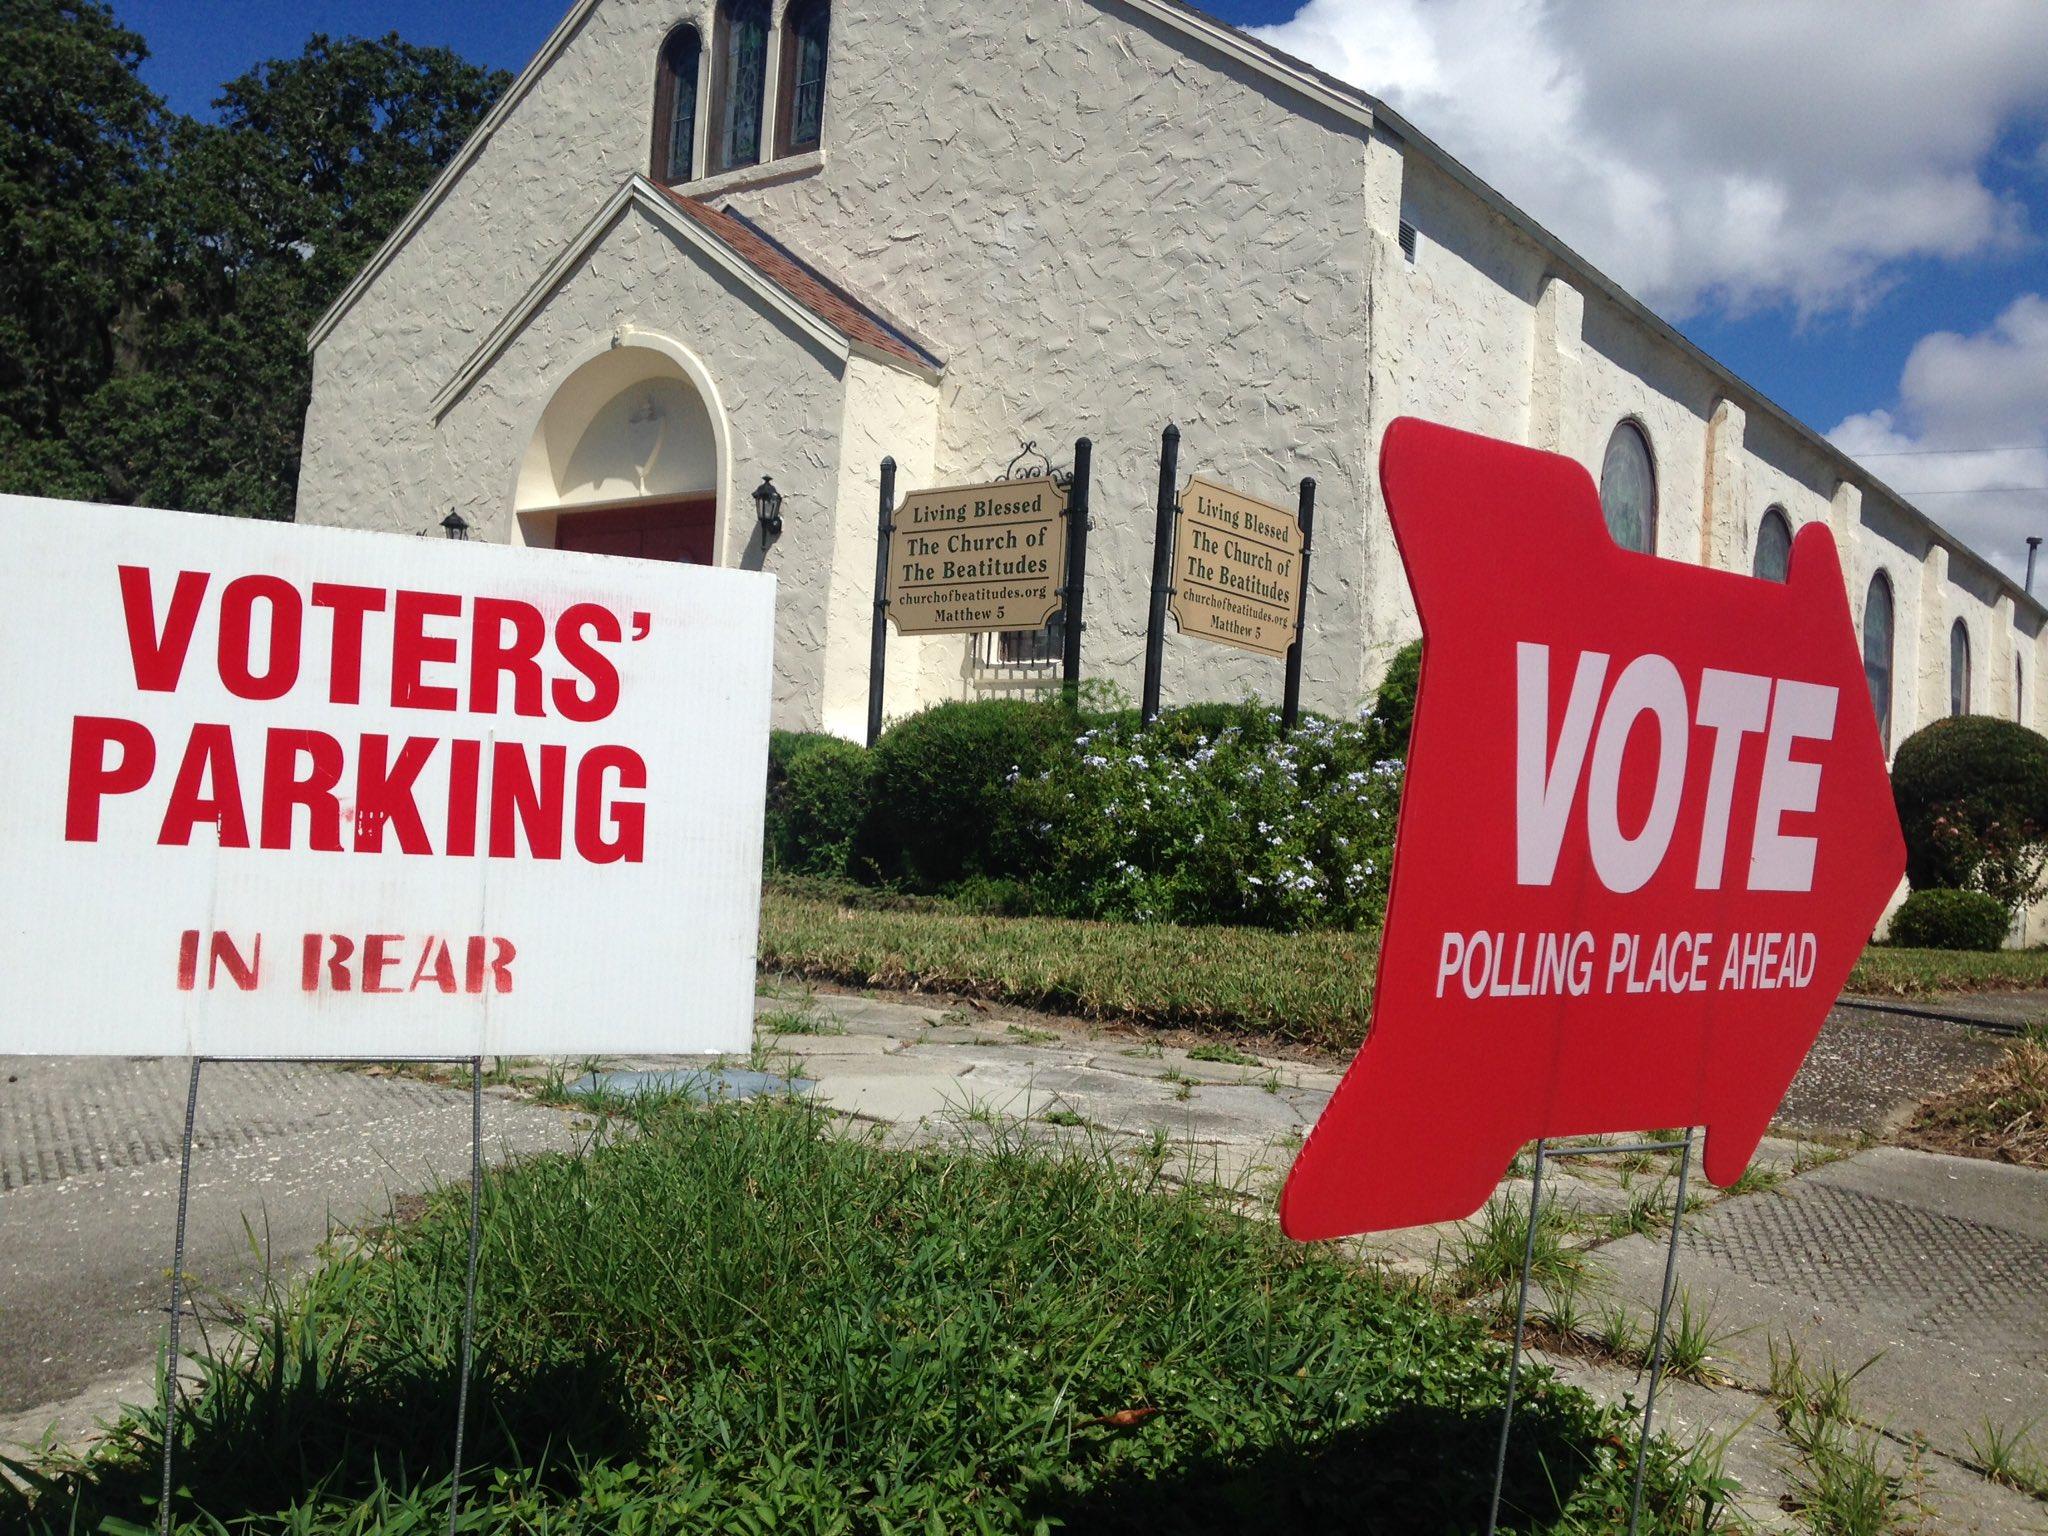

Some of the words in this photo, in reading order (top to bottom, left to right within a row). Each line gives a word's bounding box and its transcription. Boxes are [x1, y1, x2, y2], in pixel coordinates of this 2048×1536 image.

[913, 503, 967, 523] Living
[974, 495, 1041, 518] Blessed
[1197, 496, 1239, 530] Living
[1244, 513, 1289, 543] Blessed
[907, 538, 939, 557] The
[948, 531, 1018, 553] Church
[1026, 528, 1048, 546] of
[1192, 530, 1218, 555] The
[1224, 540, 1272, 572] Church
[1277, 559, 1291, 577] of
[903, 563, 935, 582] The
[943, 555, 1047, 578] Beatitudes
[1187, 556, 1214, 581] The
[1219, 566, 1290, 603] Beatitudes
[899, 586, 1046, 605] churchofbeatitudes.org
[935, 608, 992, 622] Matthew
[997, 606, 1005, 619] 5
[1183, 589, 1288, 628] churchofbeatitudes.org
[1210, 615, 1252, 638] Matthew
[1254, 626, 1261, 640] 5
[1516, 641, 1840, 894] VOTE
[65, 715, 648, 864] PARKING
[177, 930, 261, 991] IN
[301, 933, 517, 994] REAR
[1436, 930, 1595, 999] POLLING
[1606, 931, 1713, 995] PLACE
[1719, 932, 1817, 990] AHEAD
